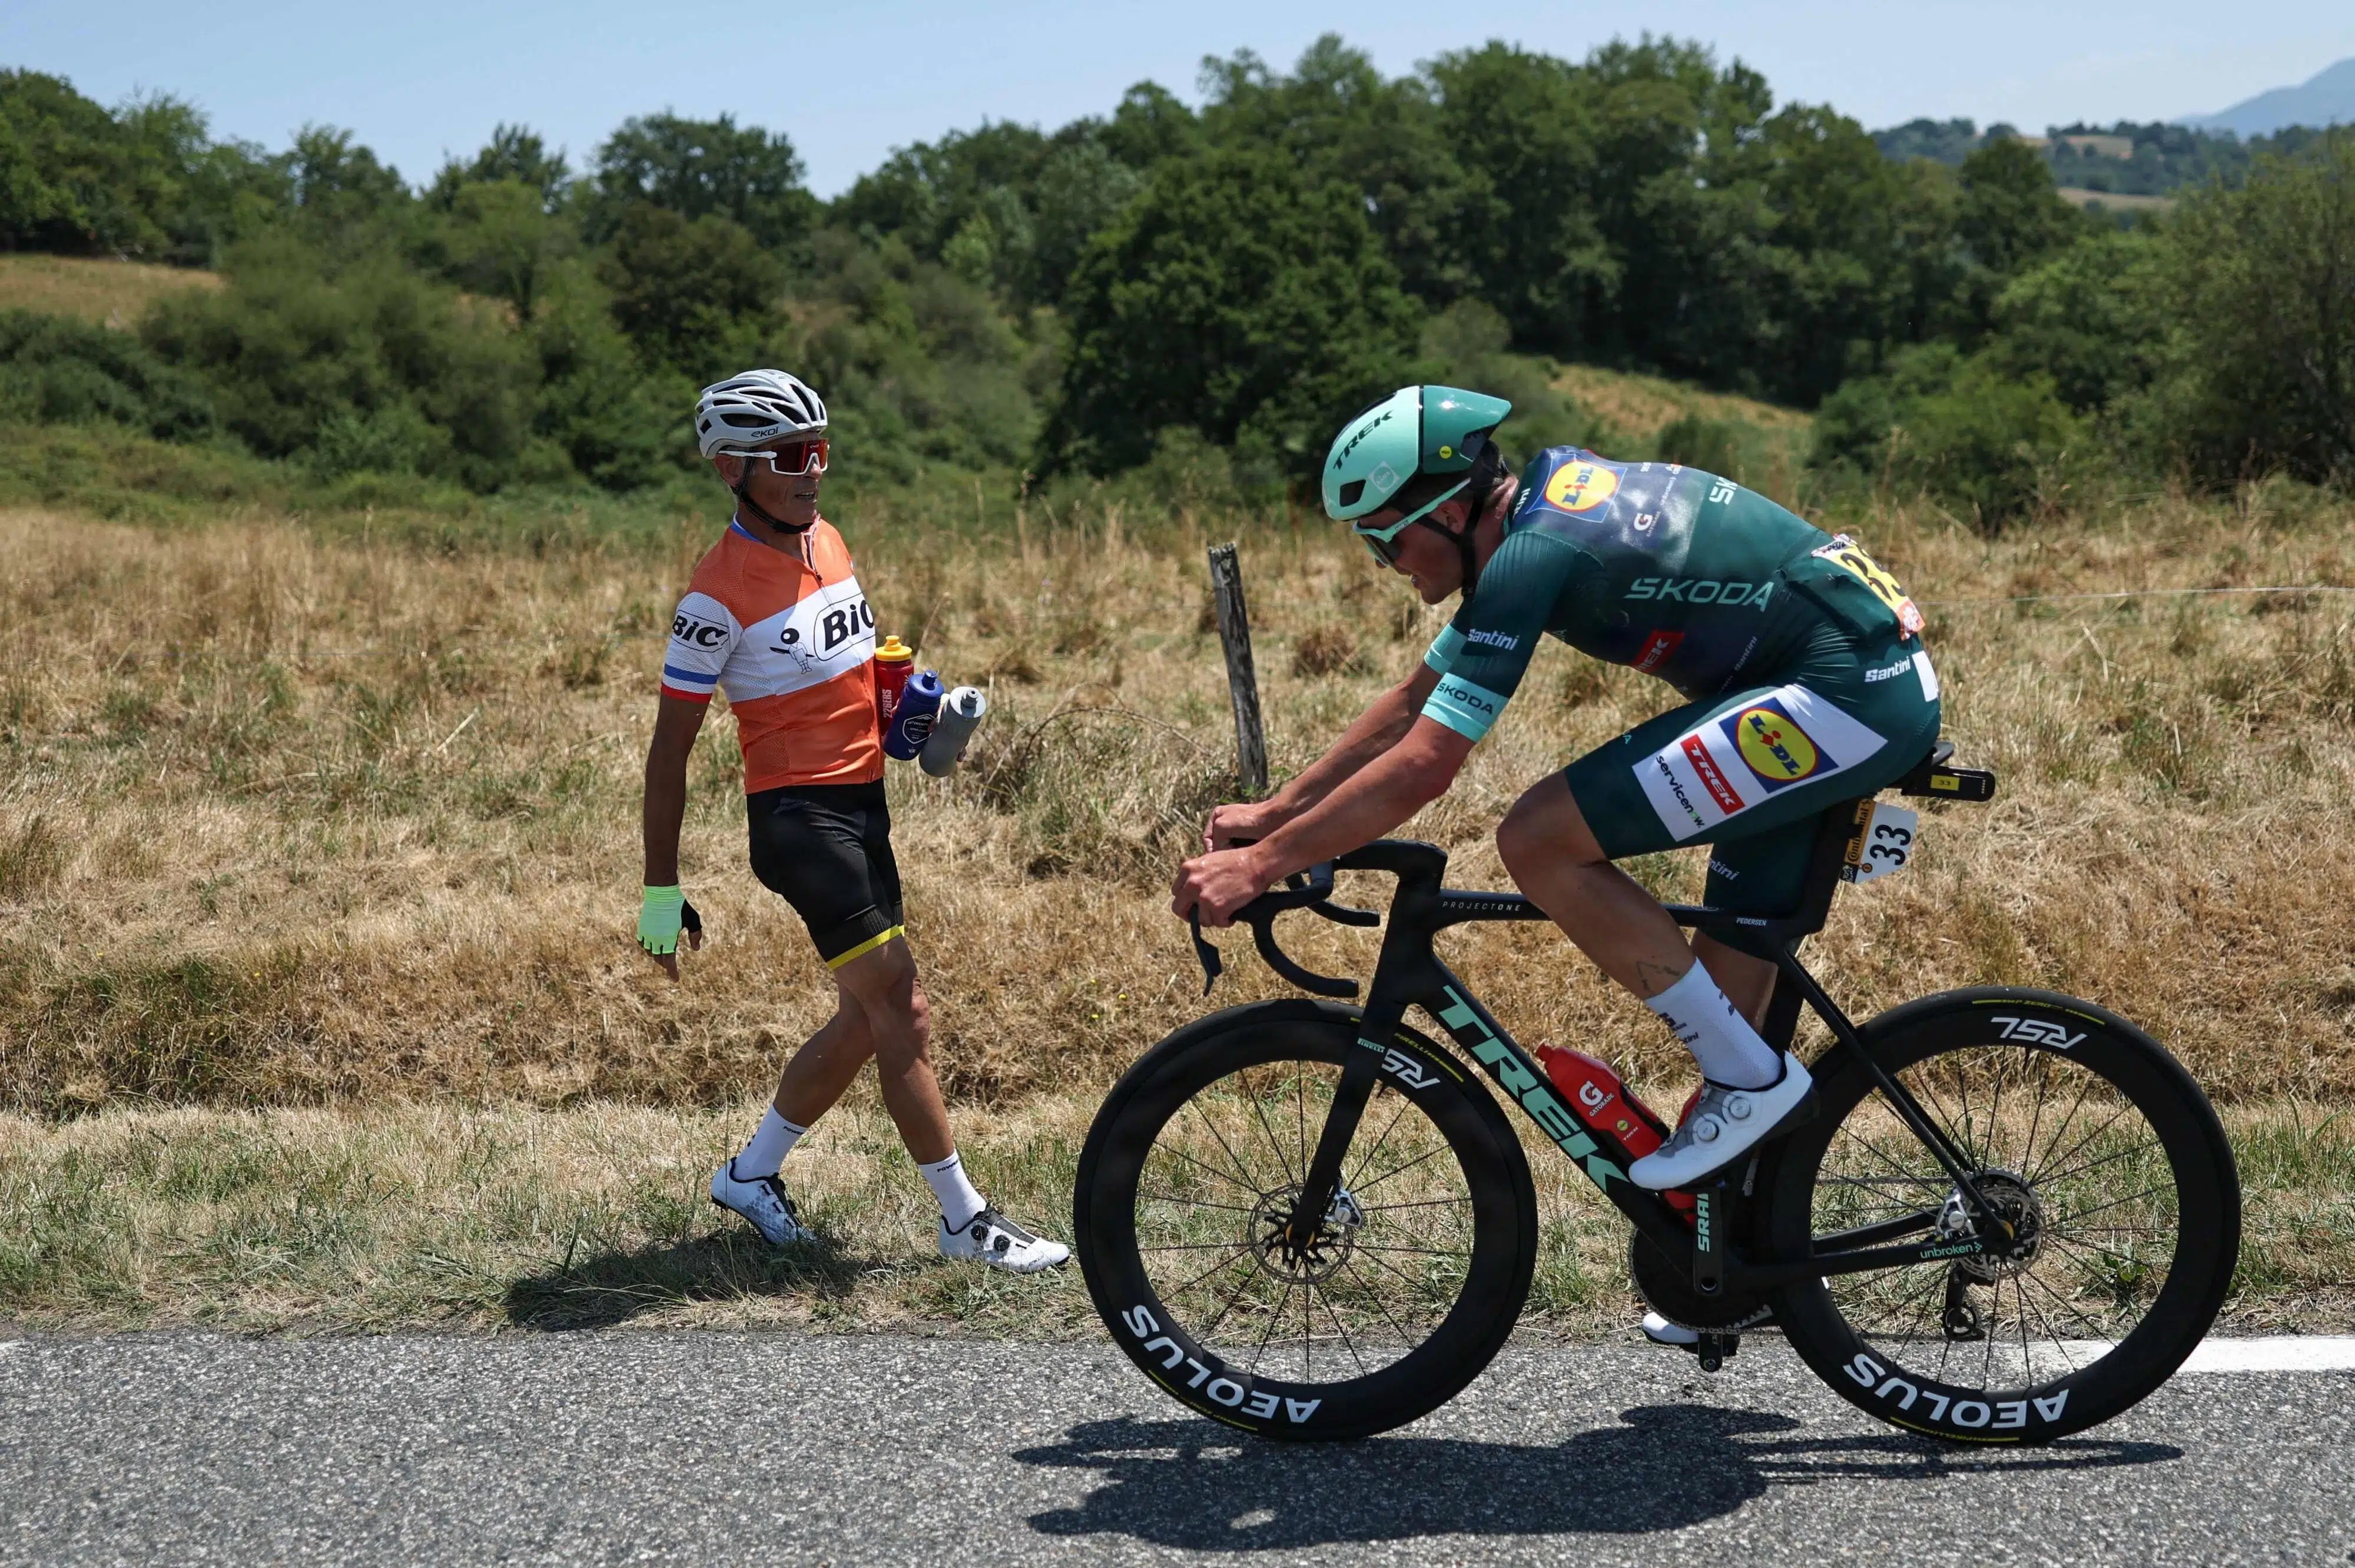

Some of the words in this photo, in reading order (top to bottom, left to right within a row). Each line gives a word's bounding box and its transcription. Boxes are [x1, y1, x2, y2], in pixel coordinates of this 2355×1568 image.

[1334, 410, 1394, 470] TREK
[1623, 578, 1774, 613] SKODA
[1467, 629, 1520, 650] Santini
[1865, 656, 1911, 683] Santini
[1437, 683, 1494, 715] SKODA
[1691, 743, 1736, 806] TREK
[1870, 825, 1911, 865] 33
[1736, 918, 1767, 926] PEDERSEN
[1381, 1048, 1441, 1089] RS
[1439, 985, 1630, 1193] TREK
[1580, 1081, 1604, 1105] G
[1589, 1092, 1614, 1117] GATORADE
[1920, 1244, 1973, 1259] unbroken
[1122, 1304, 1322, 1424] AEOLUS
[1843, 1353, 2070, 1429] AEOLUS
